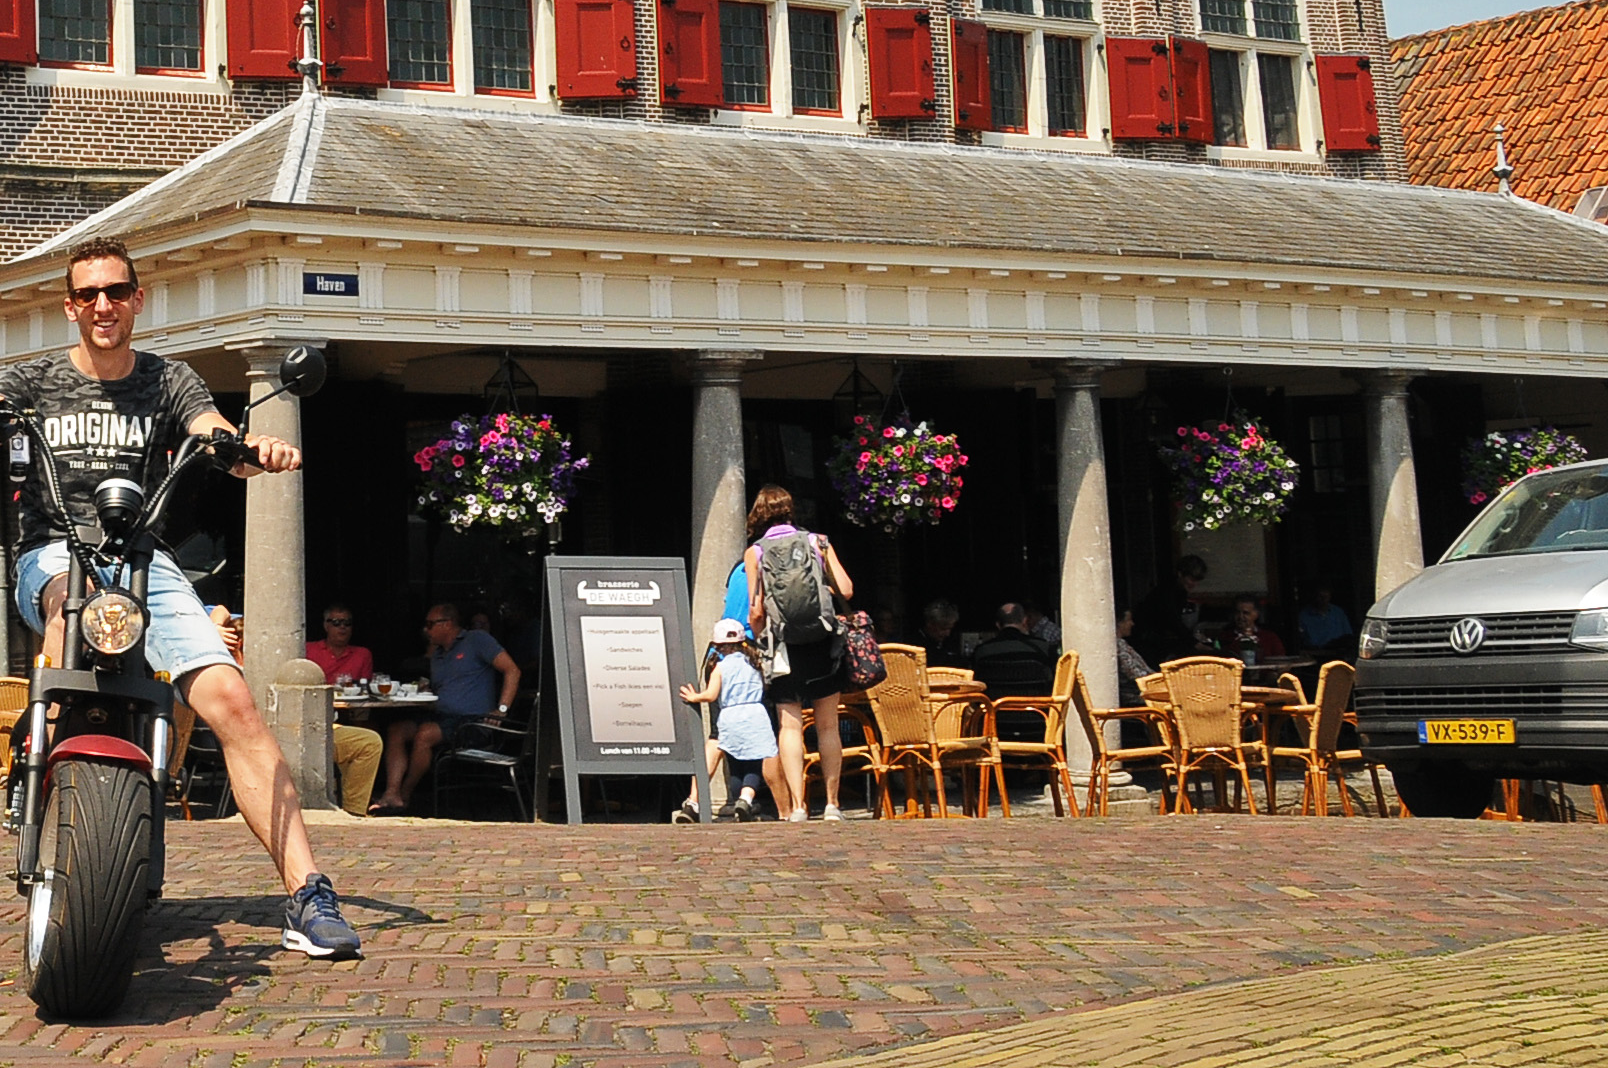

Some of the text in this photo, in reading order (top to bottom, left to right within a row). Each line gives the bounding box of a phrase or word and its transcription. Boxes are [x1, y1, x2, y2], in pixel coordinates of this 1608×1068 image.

[316, 275, 346, 292] Haven
[597, 580, 640, 588] brasserie
[590, 592, 650, 602] DE WAEGH
[1431, 723, 1506, 740] VX-539-F
[600, 747, 620, 755] Lunch
